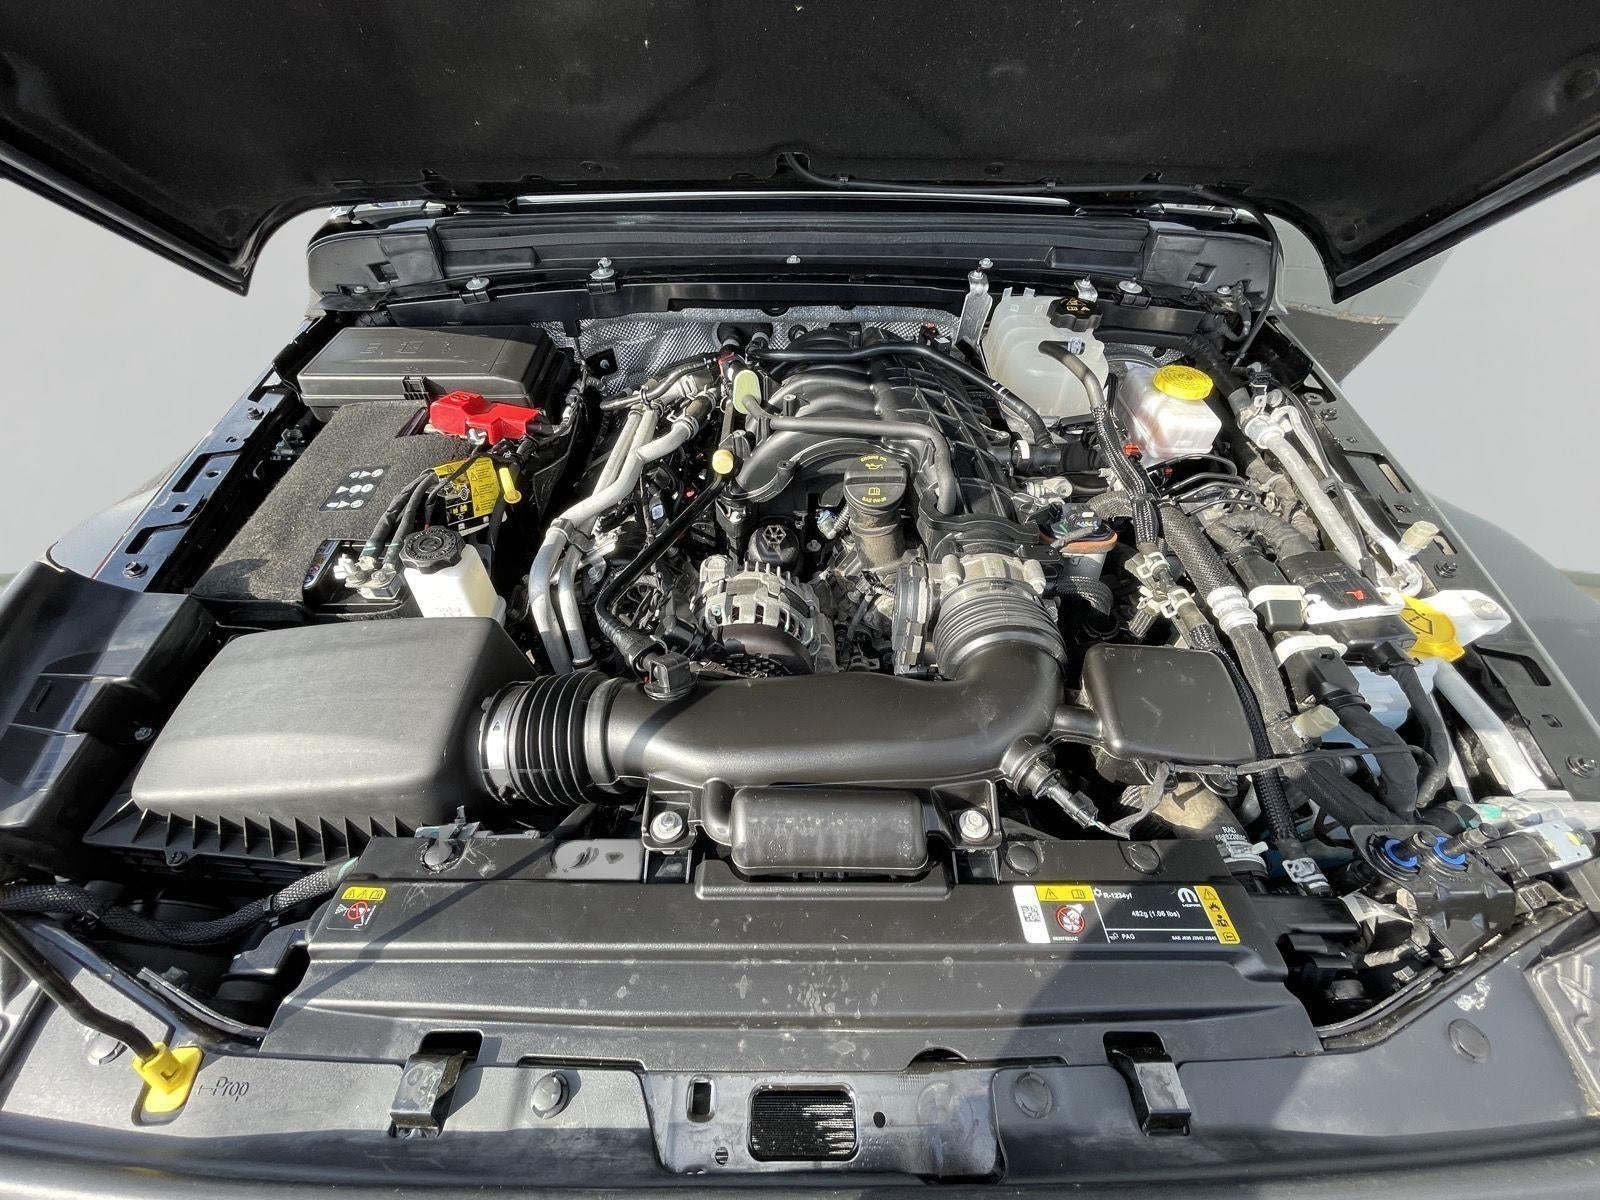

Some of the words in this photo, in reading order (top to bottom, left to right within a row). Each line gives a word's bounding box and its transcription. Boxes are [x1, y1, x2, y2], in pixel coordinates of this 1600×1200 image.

[860, 455, 879, 463] ENGINE
[1221, 826, 1237, 834] RAD
[212, 1076, 250, 1102] Prop
